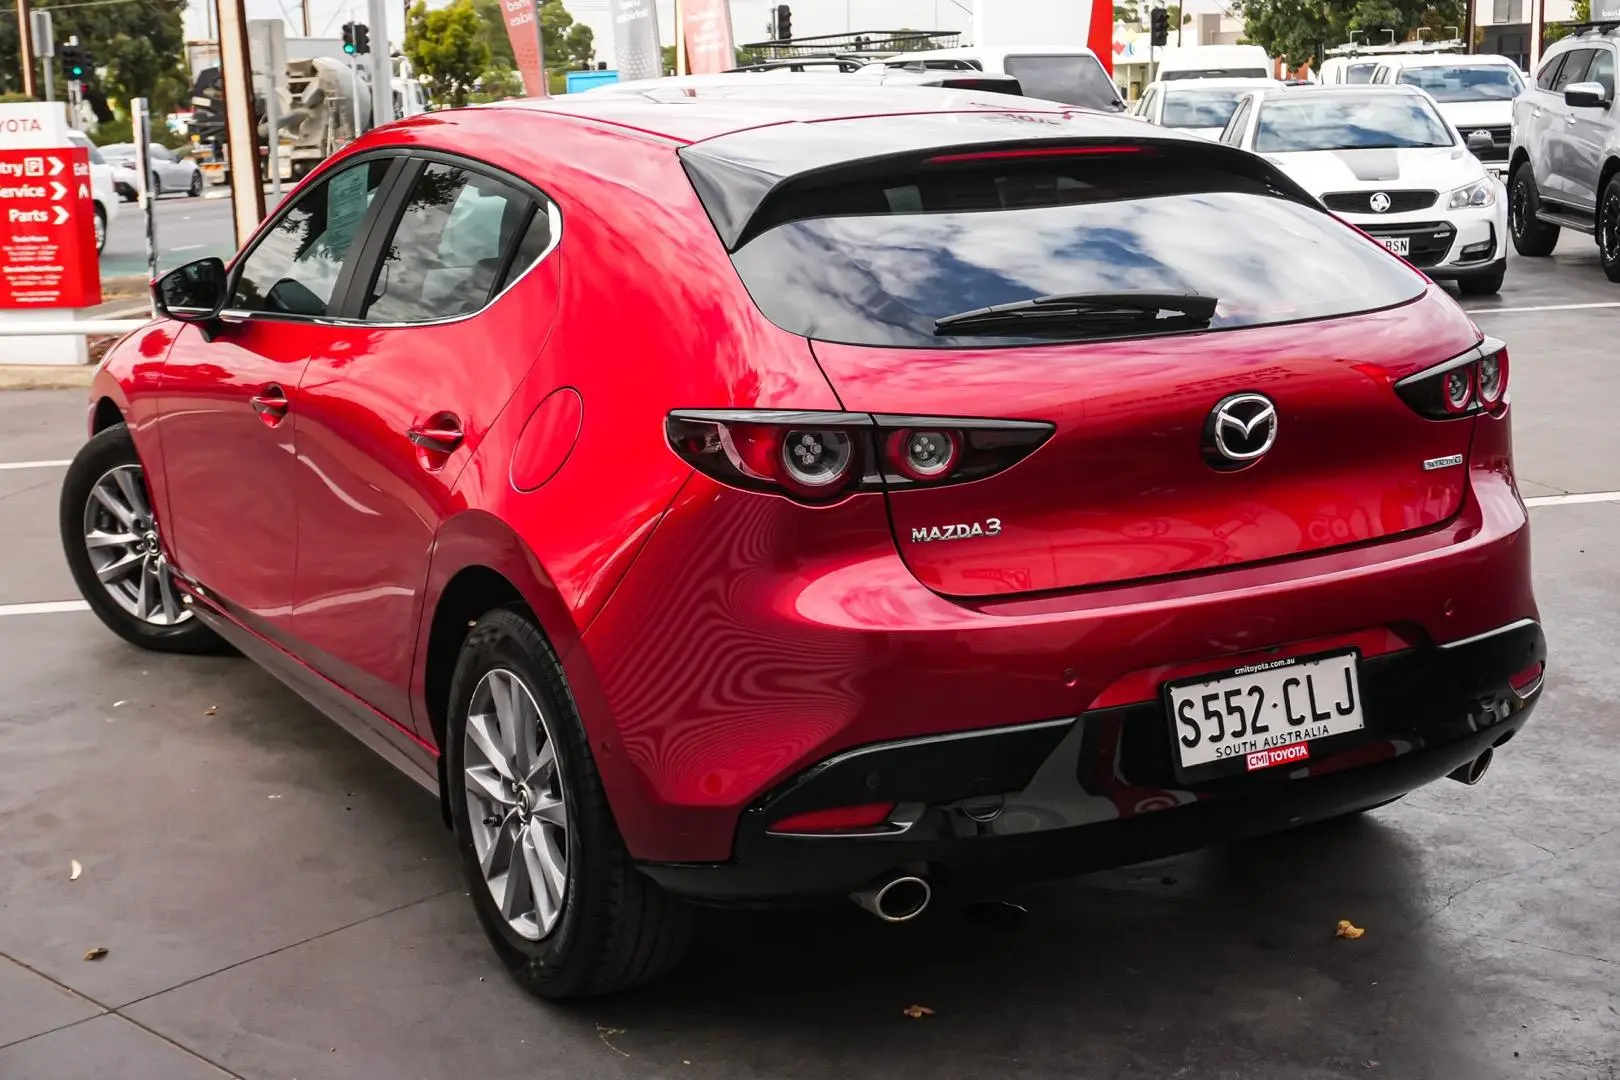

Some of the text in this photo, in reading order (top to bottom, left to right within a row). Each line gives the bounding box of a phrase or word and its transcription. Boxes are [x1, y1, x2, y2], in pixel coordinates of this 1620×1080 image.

[9, 209, 49, 222] Parts
[1234, 658, 1296, 674] cmitoyota.com.au
[1216, 725, 1330, 758] SOUTH AUSTRALIA
[1249, 745, 1307, 767] CMI TOYOTA
